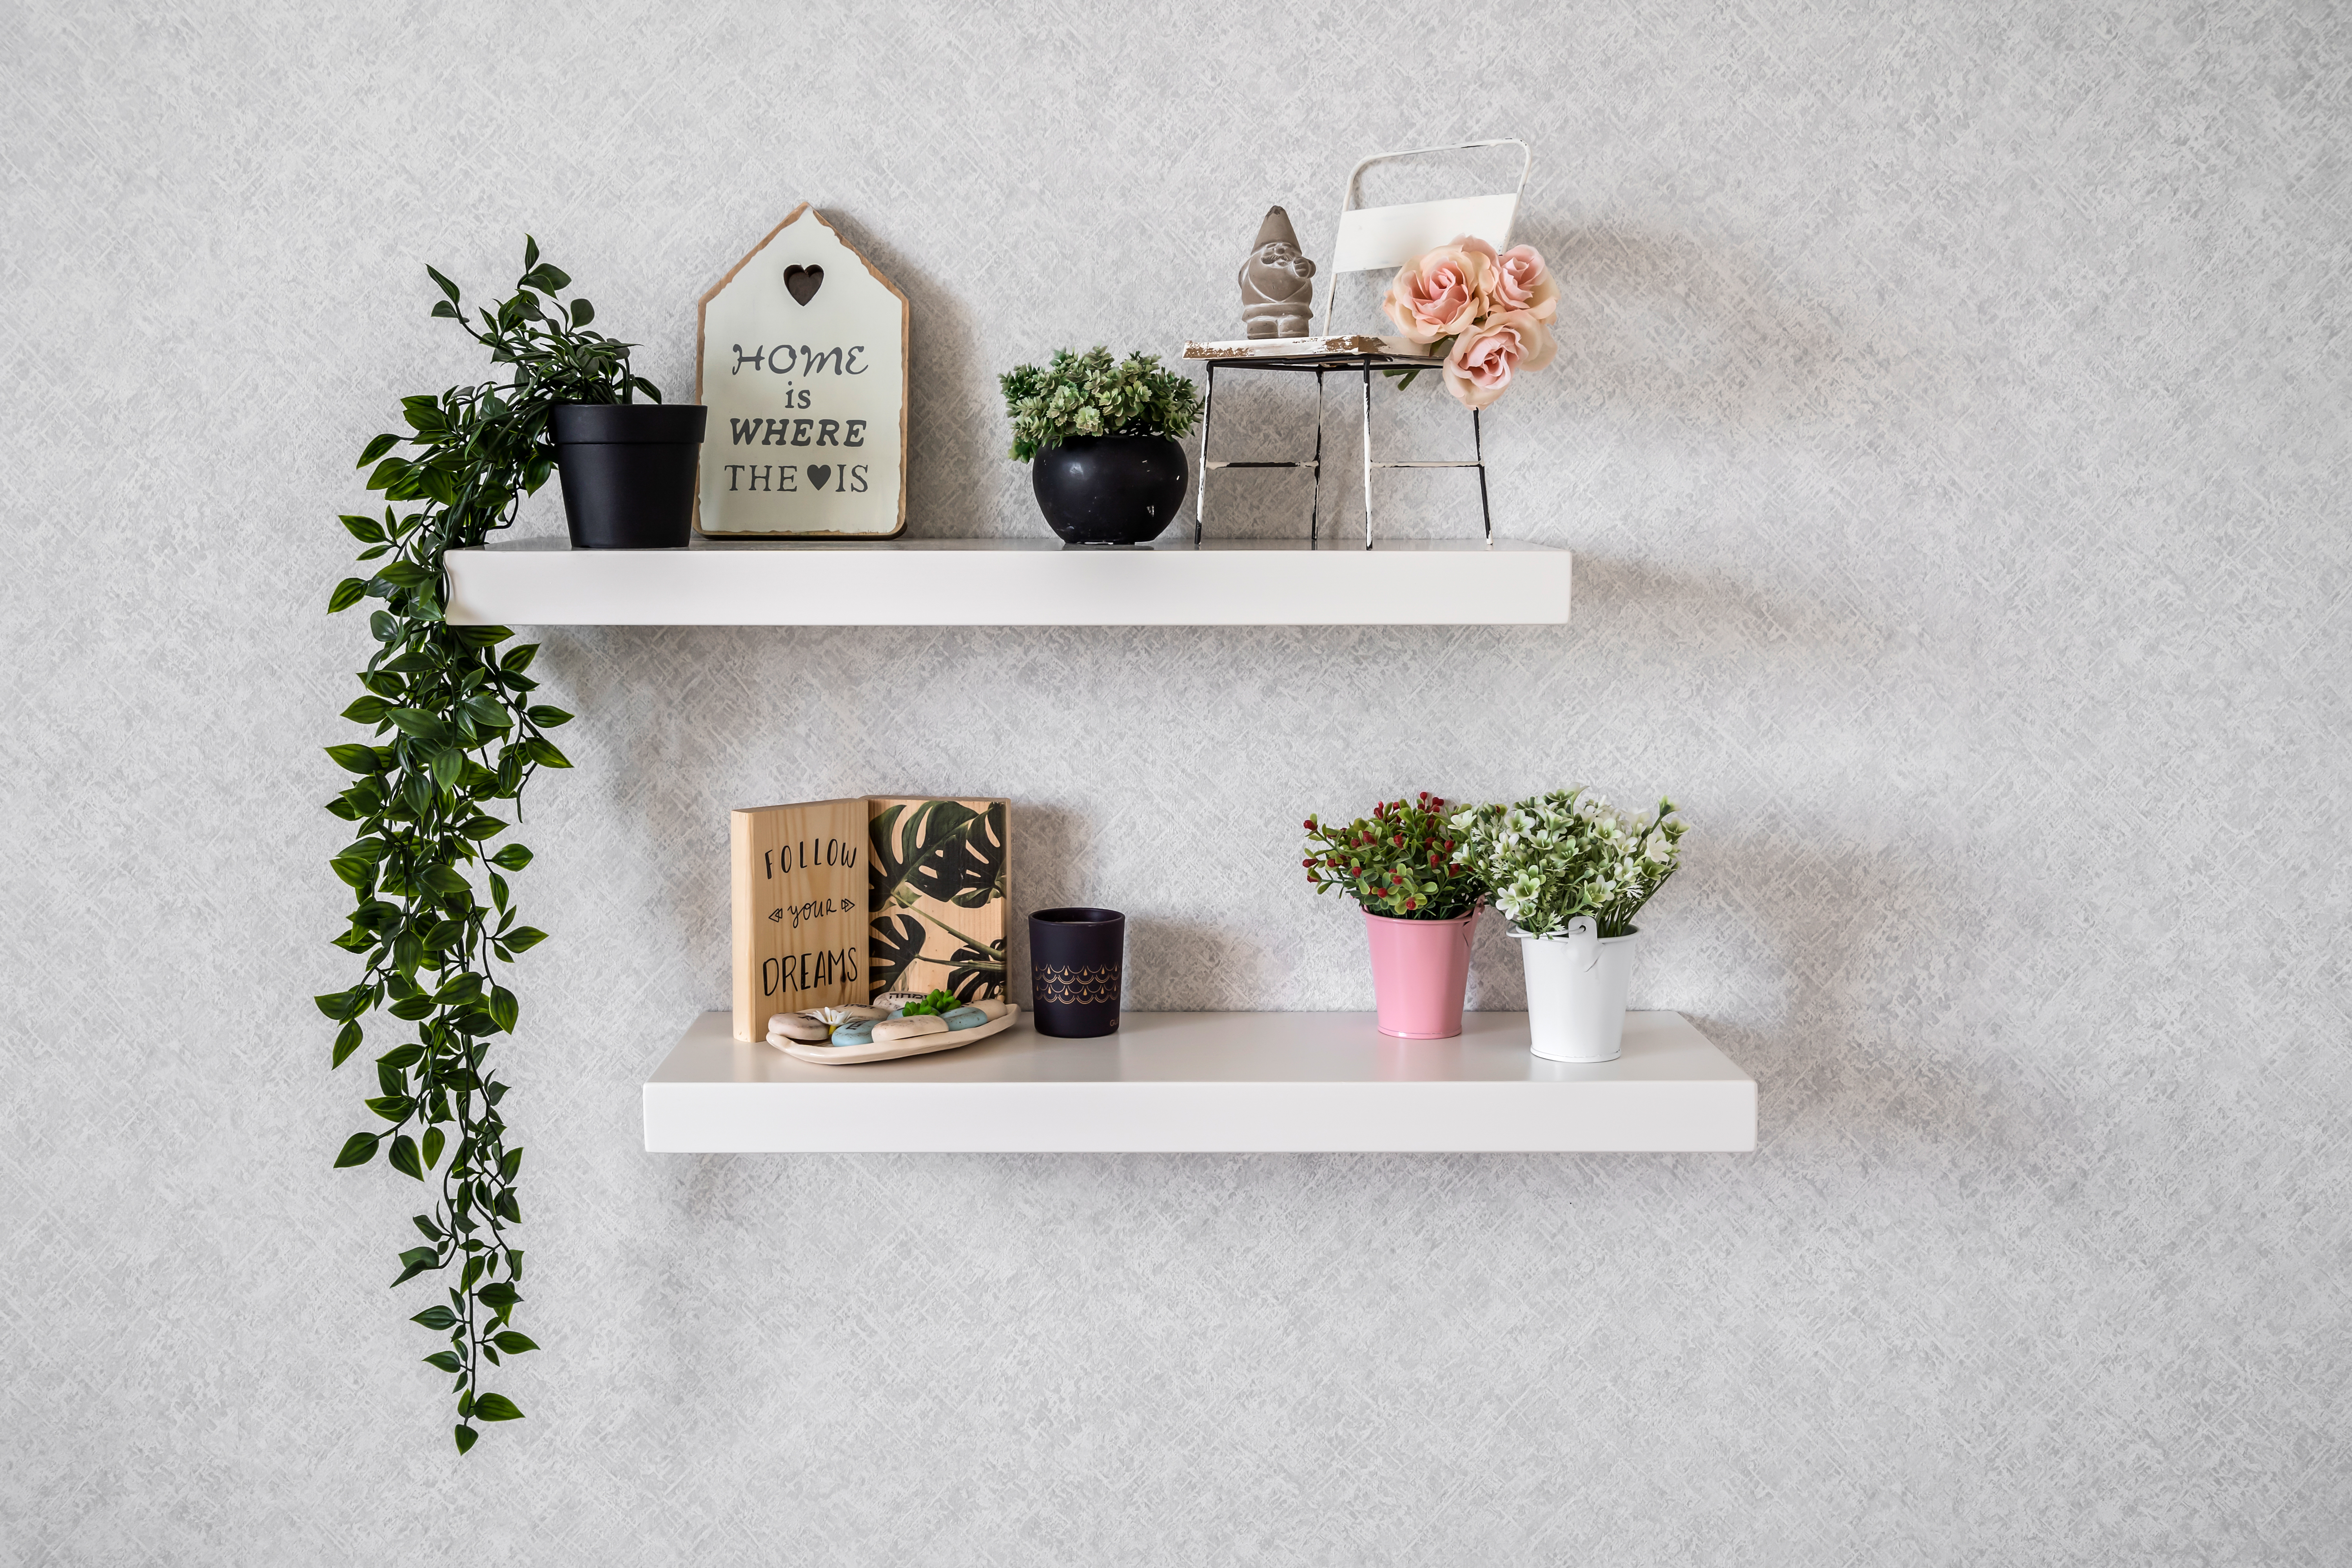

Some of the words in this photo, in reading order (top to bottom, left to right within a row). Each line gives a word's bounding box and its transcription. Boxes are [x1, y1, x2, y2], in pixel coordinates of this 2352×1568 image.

[732, 344, 869, 377] HOME
[785, 381, 811, 409] is
[730, 418, 867, 447] WHERE
[724, 464, 797, 492] THE
[835, 464, 868, 493] IS
[765, 838, 857, 880] FOLLOW
[762, 947, 858, 996] DREAMS
